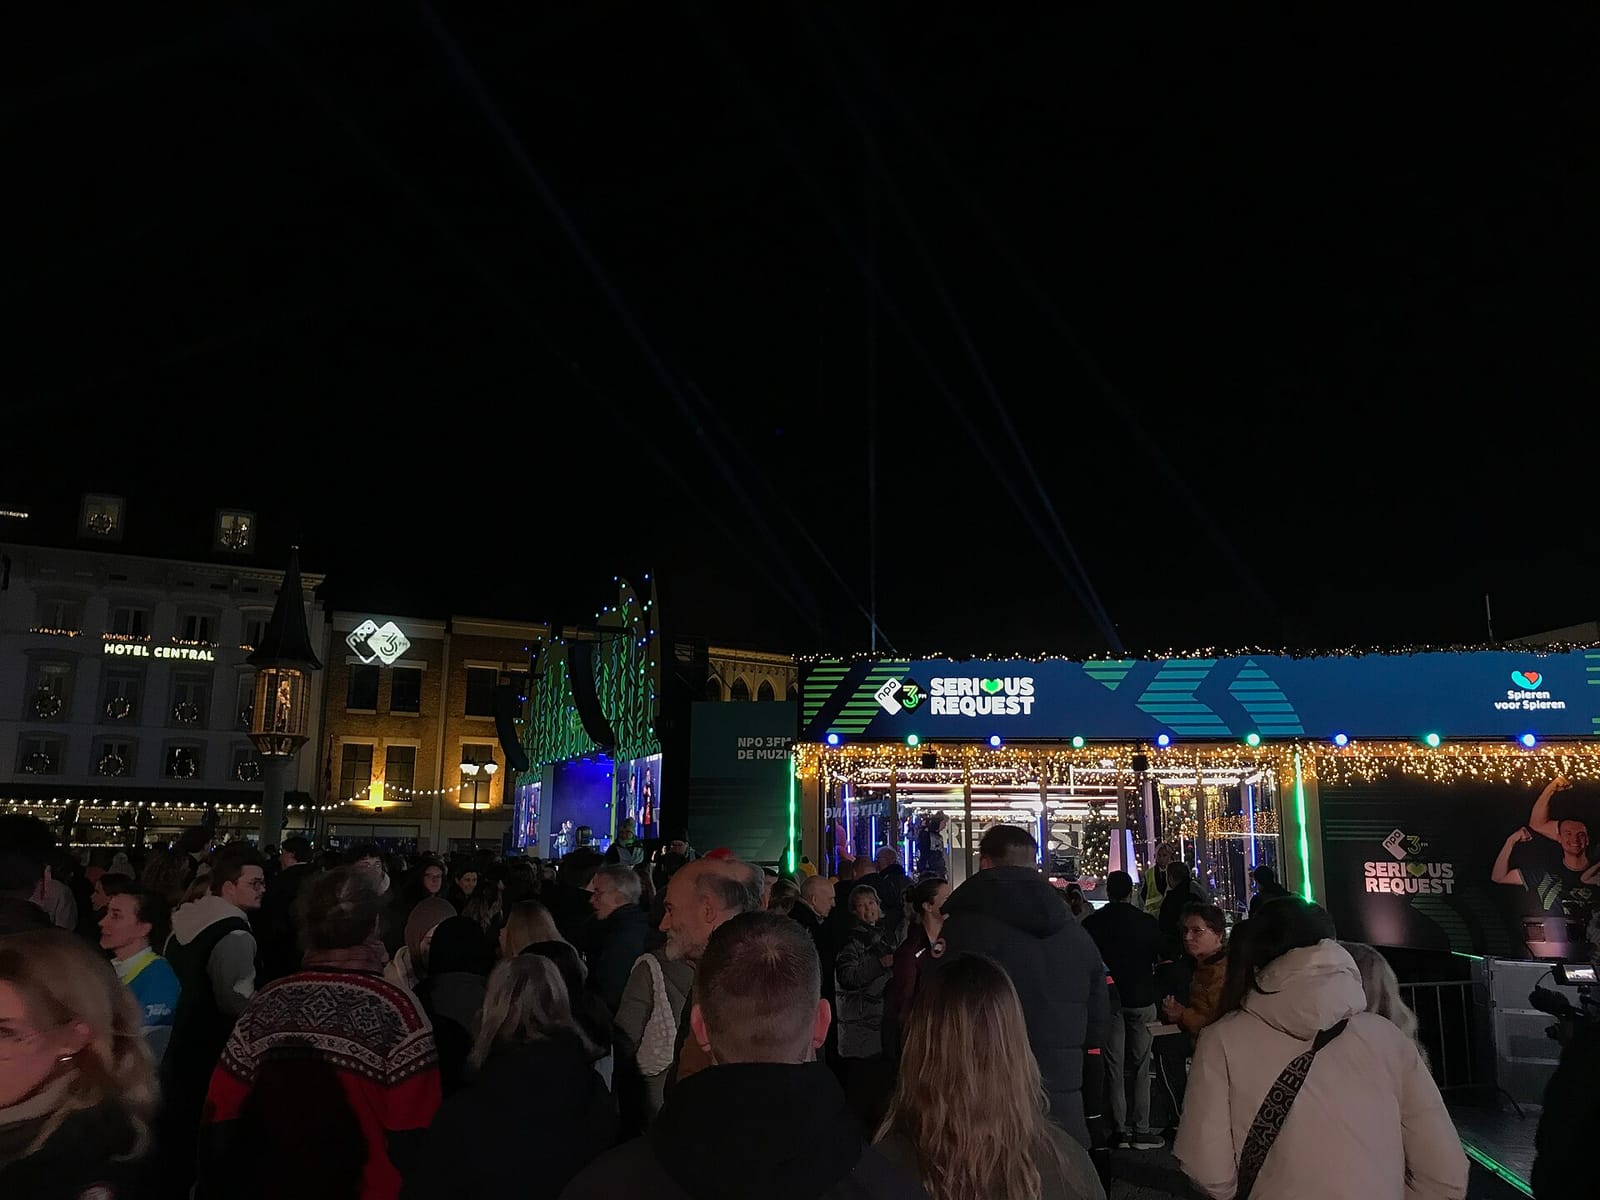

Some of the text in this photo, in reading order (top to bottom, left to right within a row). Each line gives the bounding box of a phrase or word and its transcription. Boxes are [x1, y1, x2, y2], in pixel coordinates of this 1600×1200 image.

[104, 643, 214, 661] HOTEL CENTRAL
[878, 681, 897, 701] npo
[1507, 690, 1550, 701] Spieren
[930, 697, 1035, 717] REQUEST
[1494, 700, 1566, 711] voor Spieren
[737, 737, 763, 747] NPO
[737, 749, 754, 760] DE
[1364, 878, 1455, 896] REQUEST
